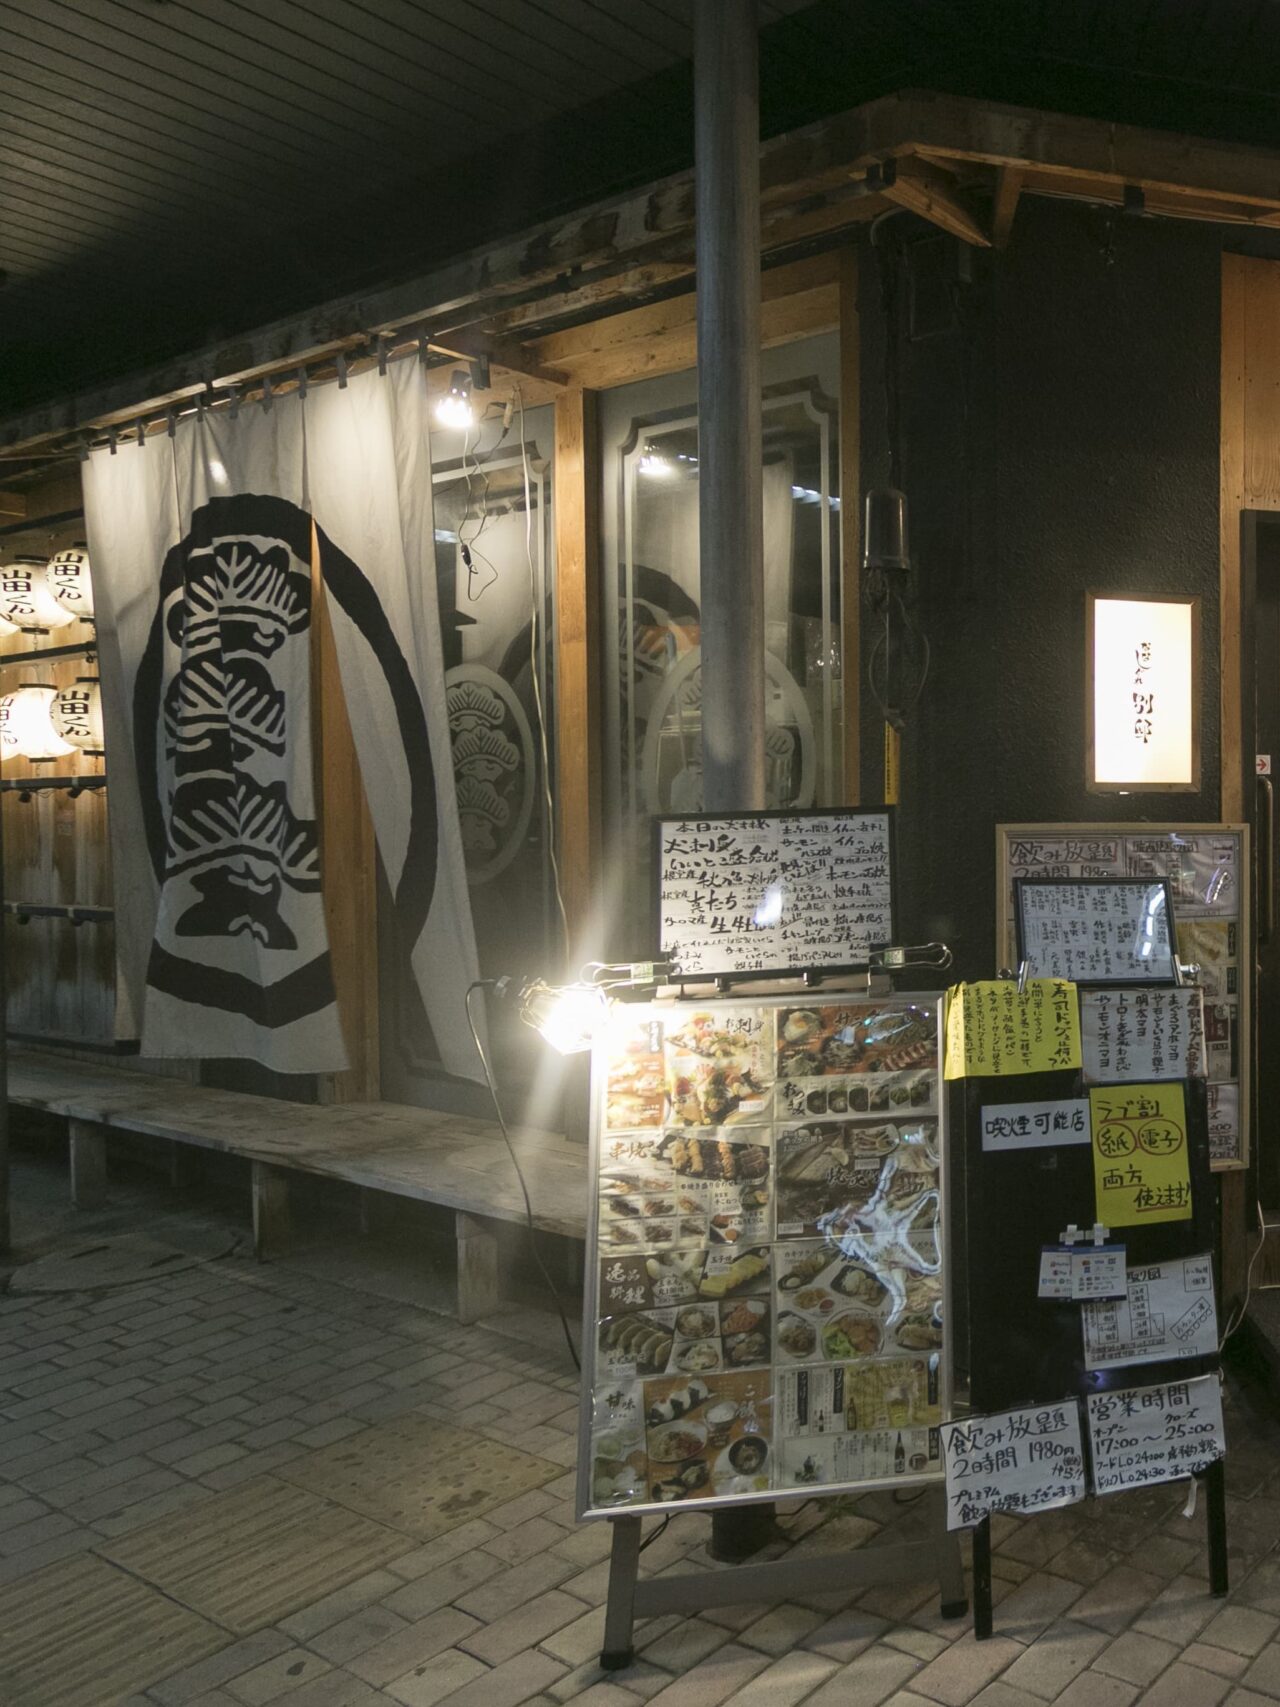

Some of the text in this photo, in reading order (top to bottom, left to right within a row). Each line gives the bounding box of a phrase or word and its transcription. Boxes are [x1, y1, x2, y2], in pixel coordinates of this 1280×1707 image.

[1012, 841, 1113, 864] 飲み放題
[985, 1108, 1086, 1140] 喫煙可能店
[1100, 1126, 1179, 1155] 紙 電子
[1103, 1163, 1145, 1188] 両方
[1133, 1180, 1192, 1209] 使えます!
[1090, 1384, 1190, 1421] 営業時間
[1166, 1409, 1200, 1424] クローズ
[949, 1406, 1070, 1457] 飲み放題
[952, 1440, 1075, 1480] 2時間 1980円
[950, 1486, 1002, 1507] プレミアム
